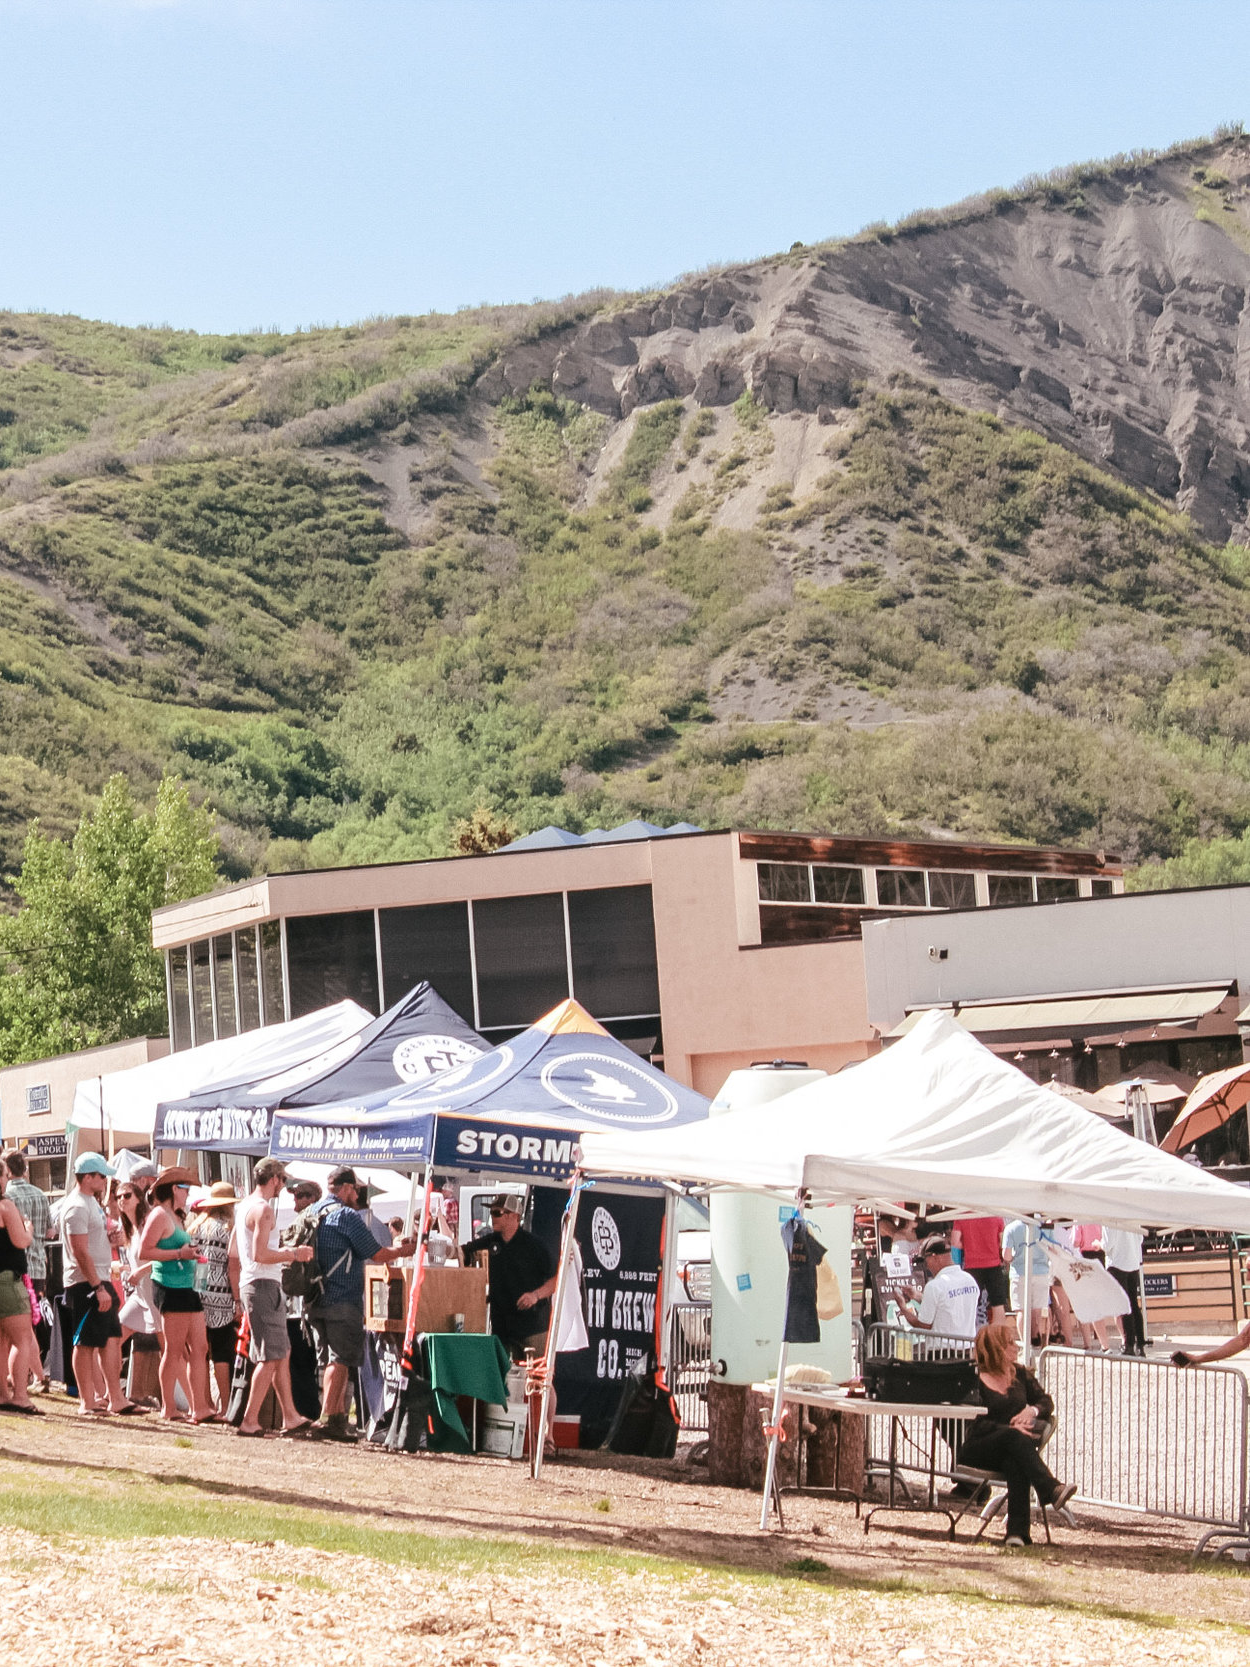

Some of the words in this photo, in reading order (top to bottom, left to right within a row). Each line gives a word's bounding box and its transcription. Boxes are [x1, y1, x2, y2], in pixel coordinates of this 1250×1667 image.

[38, 1136, 68, 1147] ASPEN
[278, 1124, 324, 1150] STORM
[324, 1126, 361, 1150] PEAK
[360, 1133, 391, 1152] brewing
[391, 1135, 425, 1152] company
[532, 1165, 576, 1175] STEAM
[638, 1271, 658, 1282] FEET
[884, 1278, 910, 1286] TICKET
[587, 1288, 607, 1328] IN
[611, 1290, 657, 1333] BREW
[596, 1338, 623, 1380] CO.
